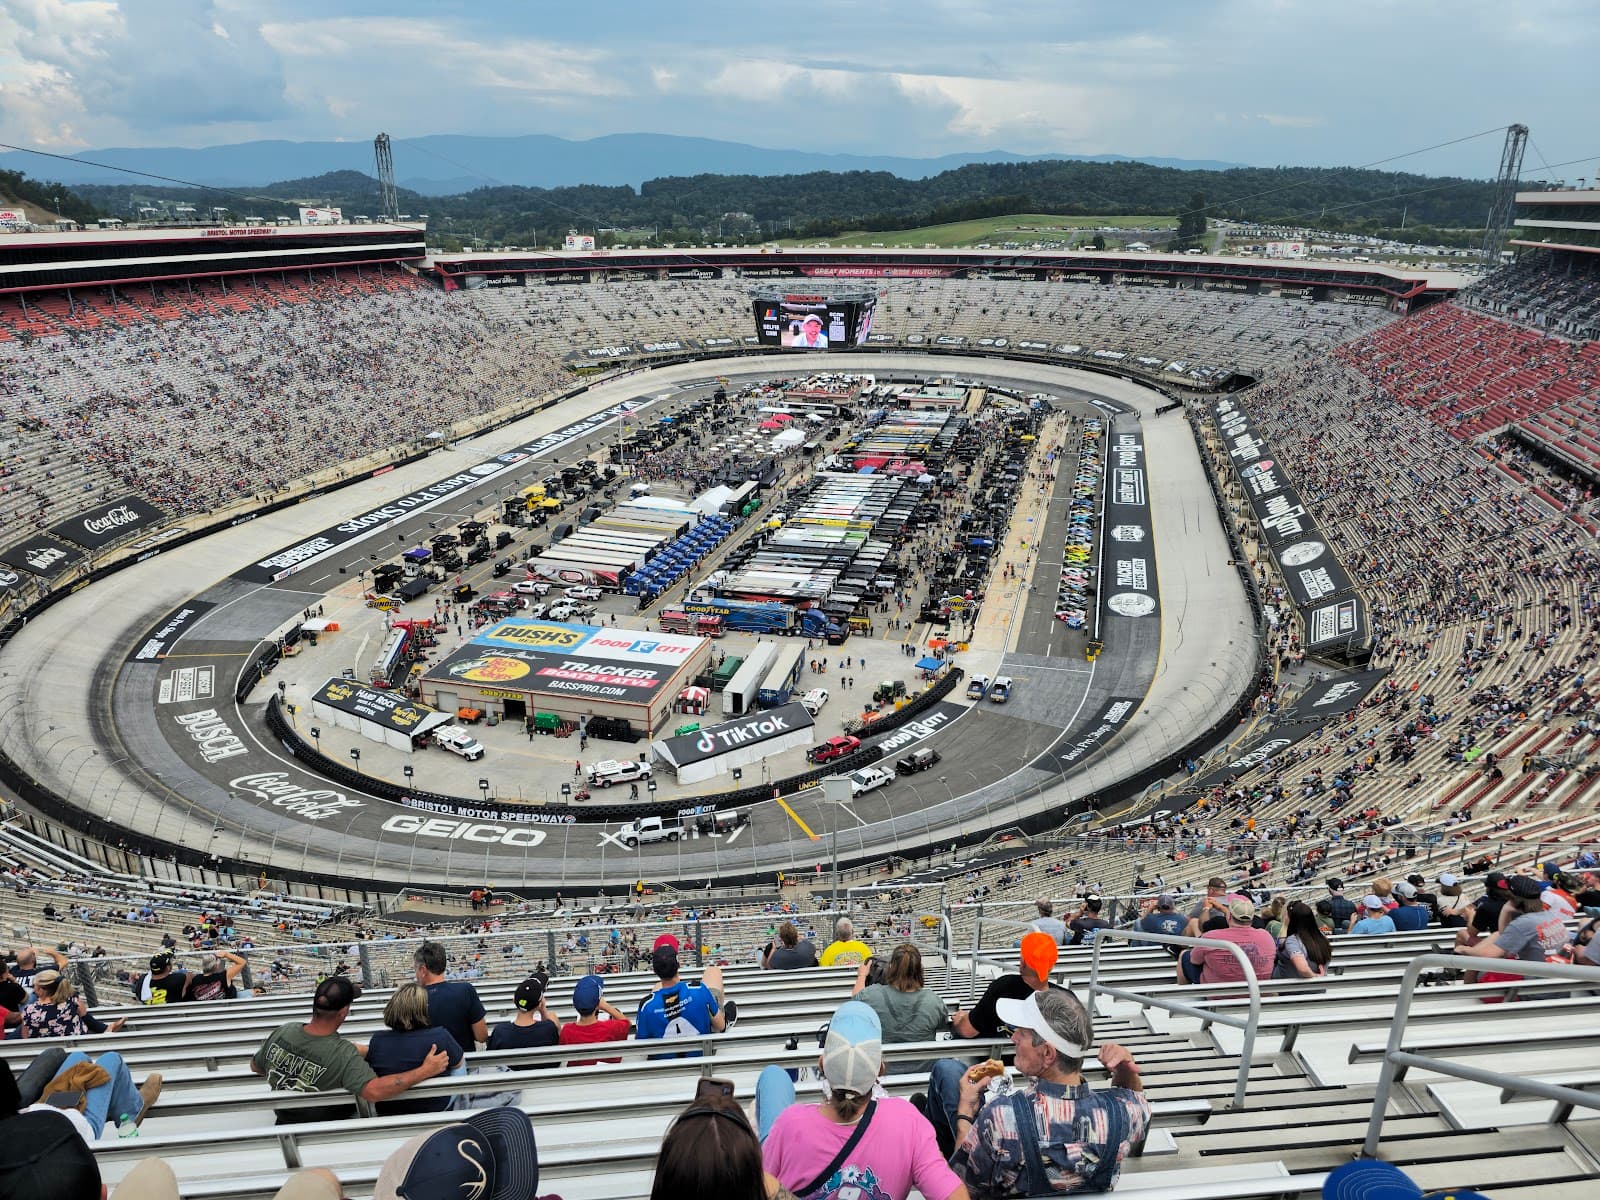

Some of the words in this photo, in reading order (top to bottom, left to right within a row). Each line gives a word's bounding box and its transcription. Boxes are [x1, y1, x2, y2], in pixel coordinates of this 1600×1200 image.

[1120, 434, 1137, 446] CITY
[1120, 451, 1137, 466] FOOD
[431, 474, 478, 494] Bass
[397, 490, 440, 509] Pro
[336, 505, 408, 533] Shops
[1117, 560, 1132, 586] TRACKER
[367, 600, 400, 610] SUNOCO
[685, 606, 731, 615] GOODYEAR
[942, 600, 975, 609] SUNOCO
[495, 627, 578, 644] BUSH'S
[590, 639, 633, 648] FOOD
[655, 645, 691, 654] CITY
[546, 669, 594, 681] BOATS
[609, 677, 649, 687] ATVs
[559, 661, 658, 679] TRACKER
[478, 690, 524, 699] GOODYEAR
[548, 680, 627, 696] BASSPRO.COM
[355, 689, 377, 701] HARD
[375, 696, 398, 709] ROCK
[354, 705, 376, 716] BRISTOL
[174, 708, 249, 765] BUSCH
[717, 715, 790, 746] TikTok
[878, 729, 912, 751] FOOD
[921, 712, 949, 729] CITY
[799, 778, 820, 791] UNOH
[229, 772, 368, 819] Coca-Cola
[410, 798, 455, 814] BRISTOL
[458, 806, 499, 820] MOTOR
[501, 811, 566, 824] SPEEDWAY
[678, 808, 695, 817] FOOD
[702, 804, 717, 813] CITY
[381, 814, 547, 847] GEICO
[266, 1042, 328, 1085] BLANEY
